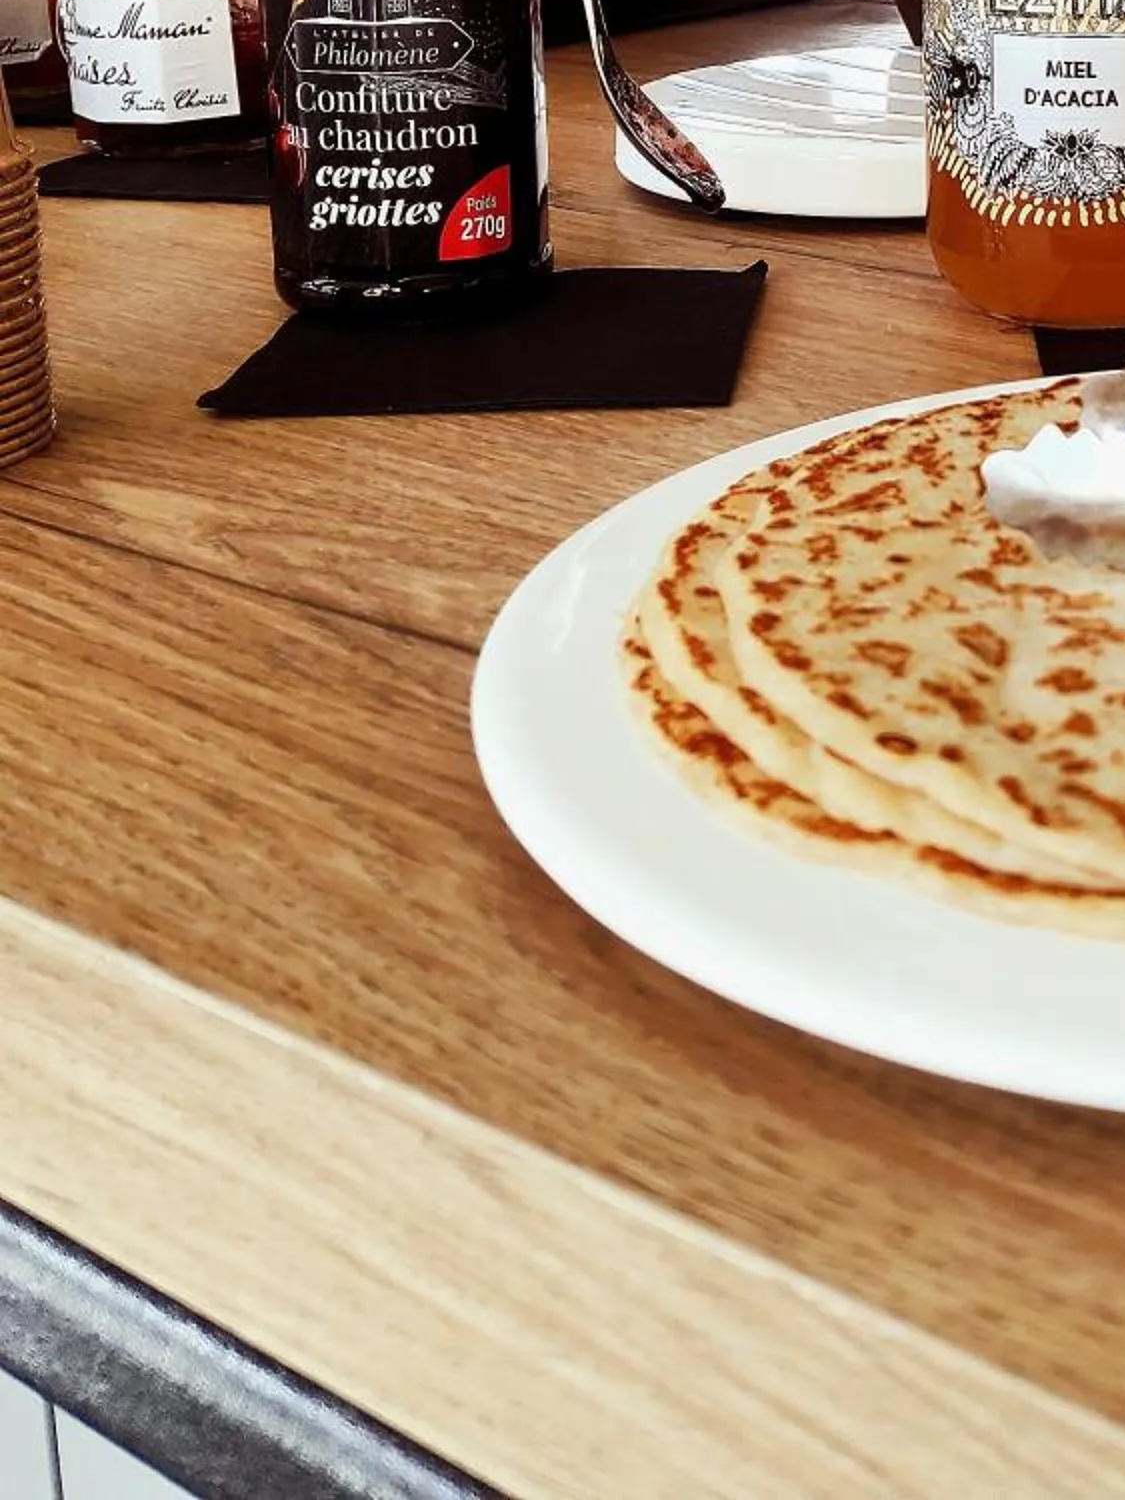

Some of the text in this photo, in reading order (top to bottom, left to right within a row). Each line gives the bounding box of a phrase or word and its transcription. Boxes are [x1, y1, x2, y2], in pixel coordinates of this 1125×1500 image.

[314, 40, 439, 66] Philomène
[1046, 61, 1097, 79] MIEL
[296, 81, 453, 114] Confiture
[1024, 88, 1119, 107] D'ACACIA
[318, 119, 480, 152] chaudron
[315, 158, 435, 189] cerises
[309, 196, 443, 231] griottes
[467, 194, 496, 213] Poids
[461, 215, 505, 240] 270g
